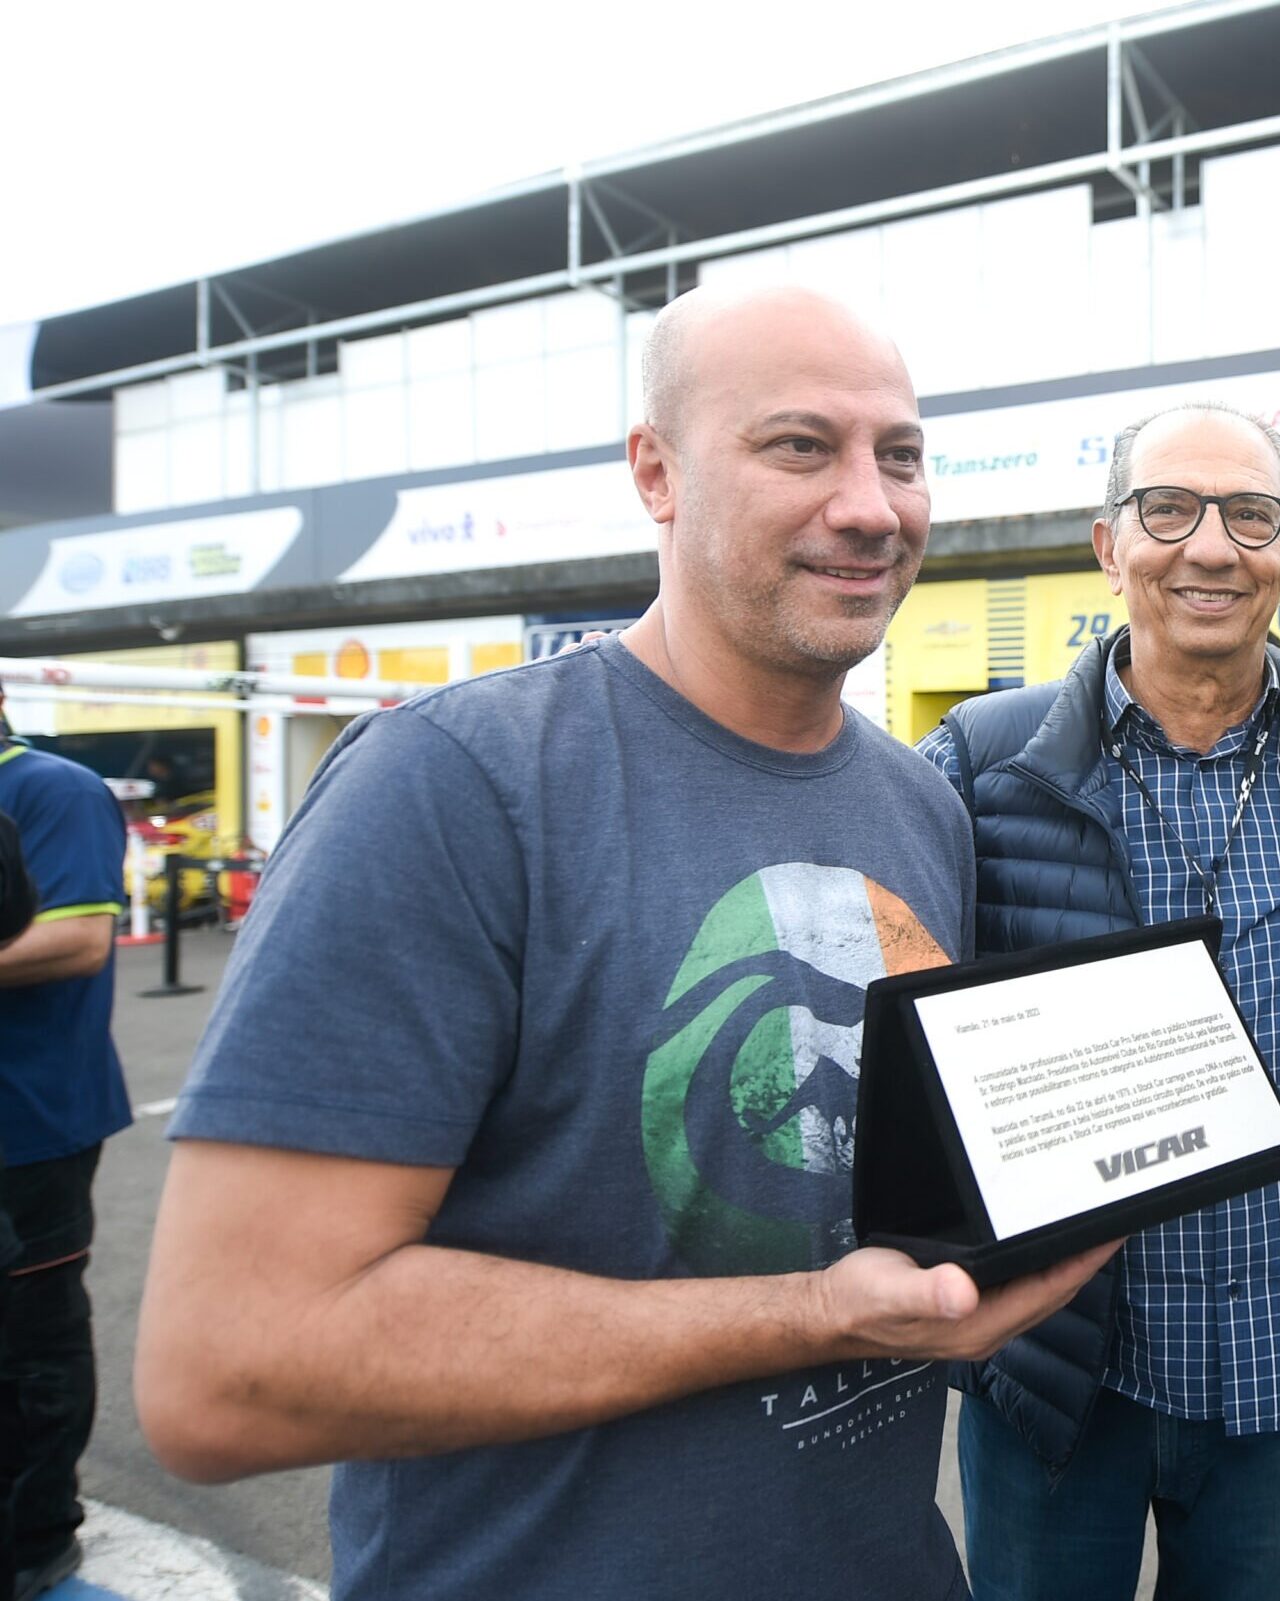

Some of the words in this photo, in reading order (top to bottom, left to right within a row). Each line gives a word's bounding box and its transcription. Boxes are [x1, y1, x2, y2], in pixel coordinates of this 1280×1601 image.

[930, 451, 1038, 477] Transzero
[1092, 1125, 1213, 1183] VICAR
[842, 1410, 906, 1449] IRELAND
